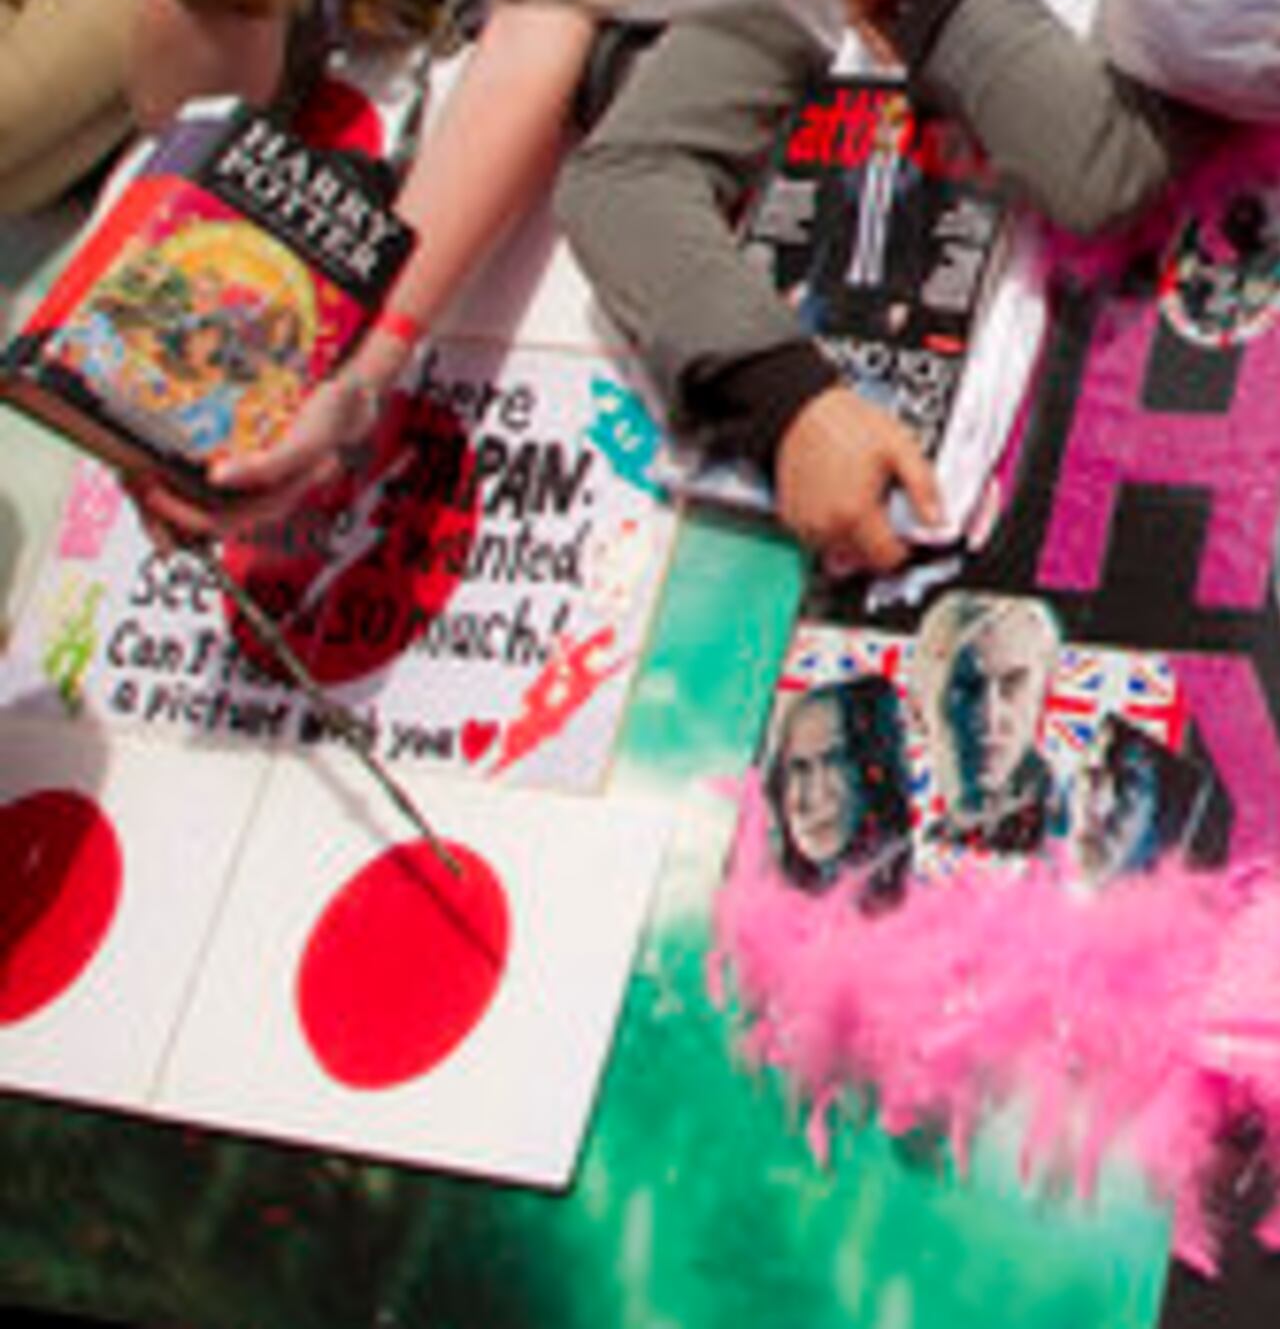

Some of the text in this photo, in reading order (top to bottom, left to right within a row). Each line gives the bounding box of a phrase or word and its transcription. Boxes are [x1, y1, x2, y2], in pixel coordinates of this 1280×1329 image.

[218, 148, 380, 283] POTTER
[242, 120, 400, 245] HARRY
[108, 619, 182, 672] Can
